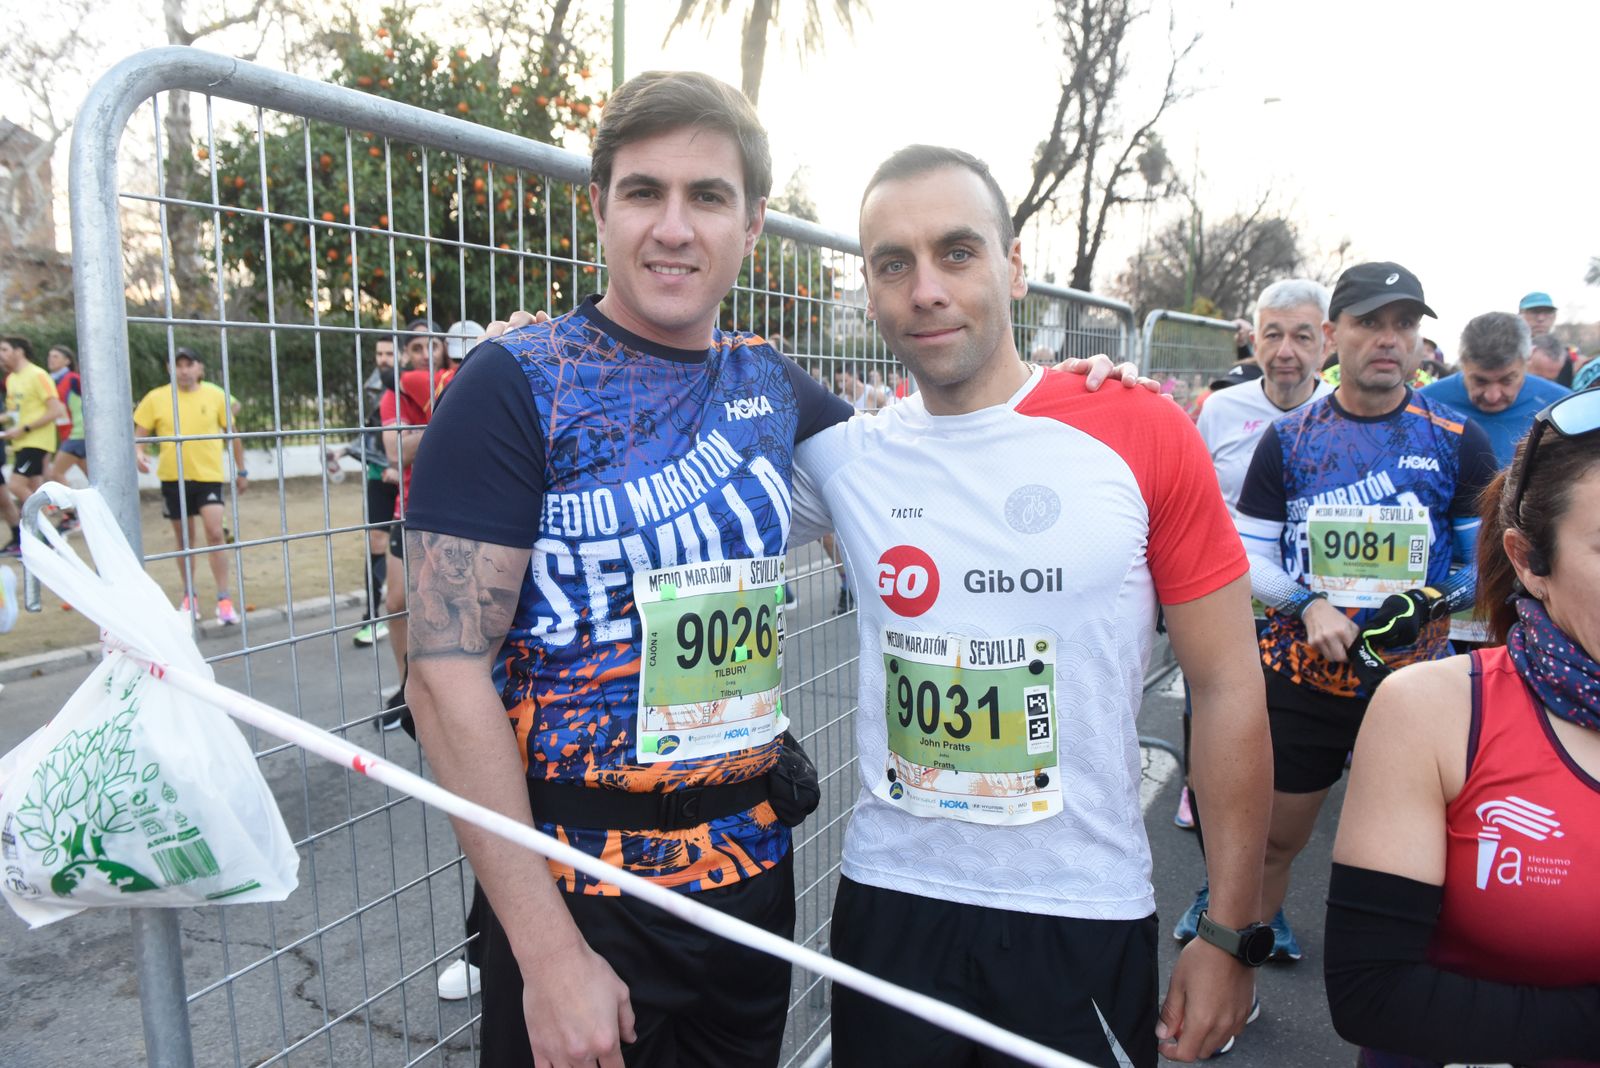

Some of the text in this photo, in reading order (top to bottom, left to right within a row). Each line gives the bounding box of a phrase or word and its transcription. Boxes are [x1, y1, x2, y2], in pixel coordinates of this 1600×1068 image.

[724, 396, 774, 421] HOKA
[1398, 455, 1440, 472] HOKA
[540, 429, 743, 537] EDIO MARATÓN
[890, 507, 923, 519] TACTIC
[1379, 507, 1414, 521] SEVILLA
[1324, 530, 1396, 562] 9081
[684, 562, 731, 587] MARATÓN
[750, 559, 779, 584] SEVILLA
[876, 562, 929, 600] GO
[963, 567, 1063, 594] Gib Oil
[676, 604, 773, 670] 9026
[886, 630, 1026, 665] MEDIO MARATÓN SEVILLA
[649, 640, 659, 666] CAJÓN
[714, 665, 752, 678] TILBURY
[720, 688, 743, 698] Tilbury
[897, 674, 1000, 740] 9031
[724, 728, 750, 740] HOKA
[919, 737, 971, 752] John Pratts
[933, 760, 956, 771] Pratts
[939, 799, 969, 810] HOKA
